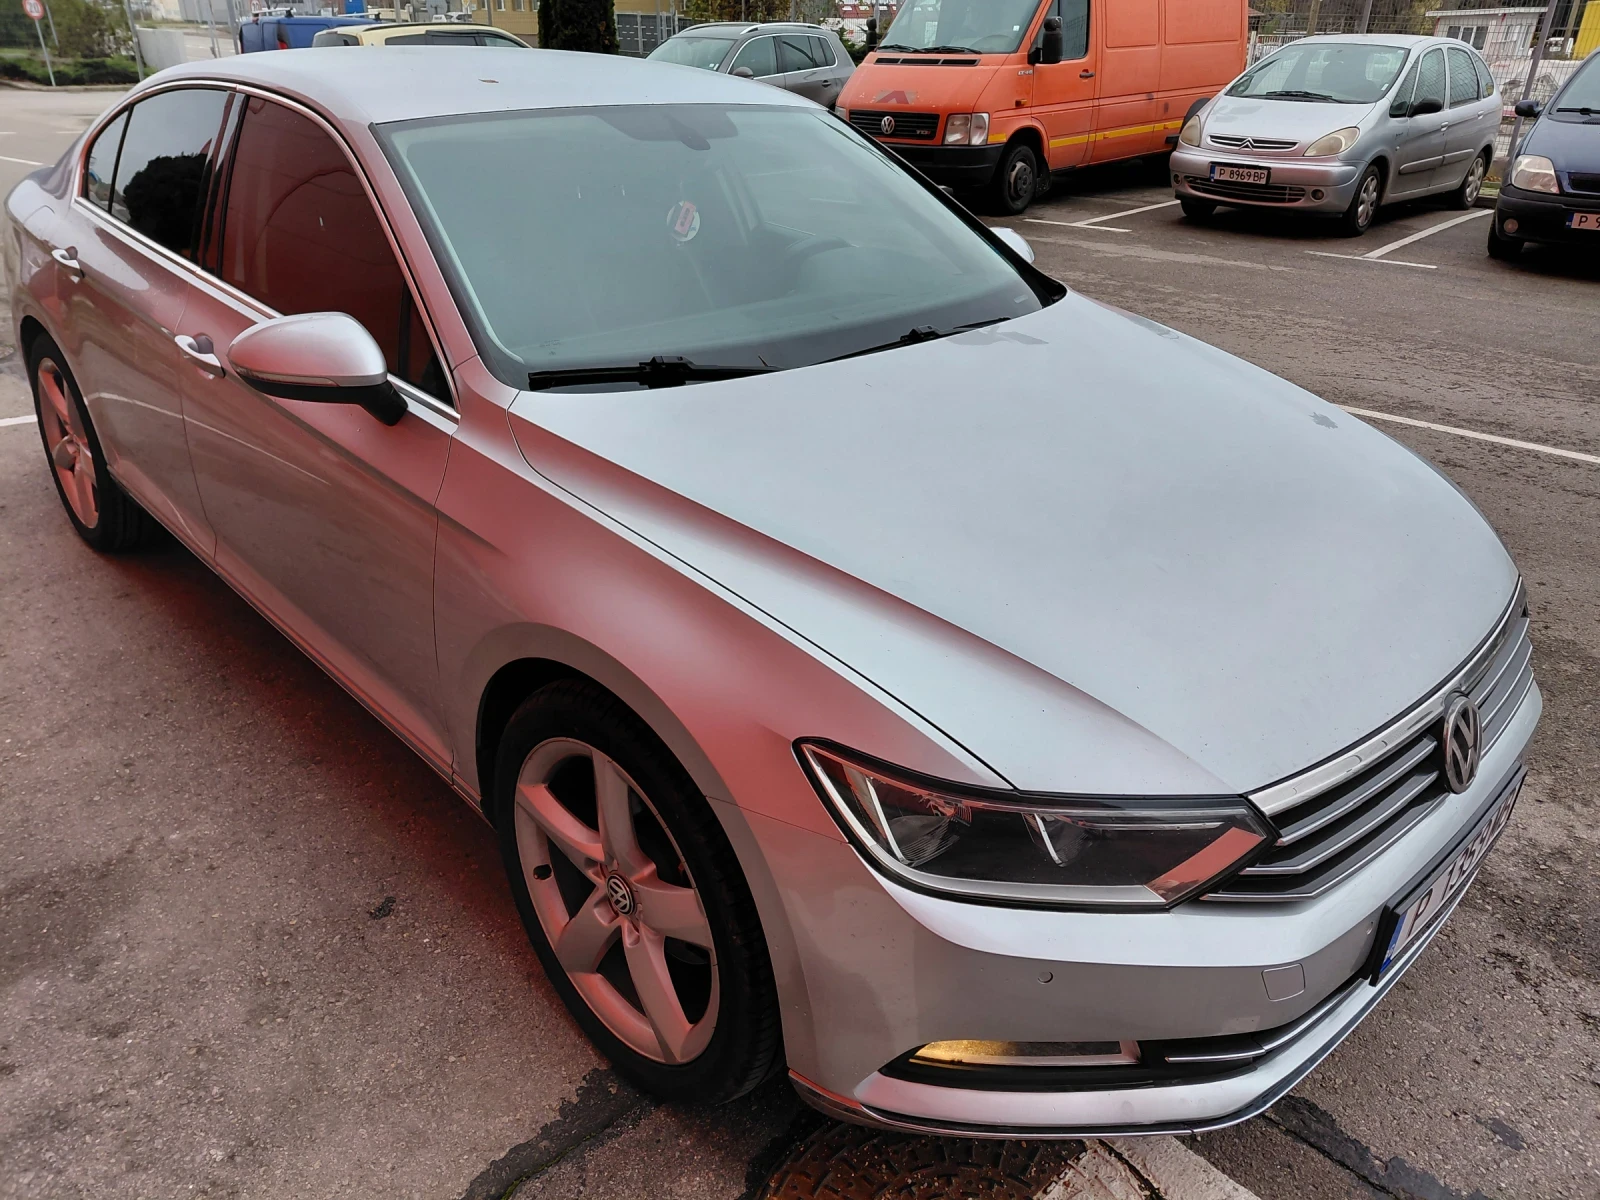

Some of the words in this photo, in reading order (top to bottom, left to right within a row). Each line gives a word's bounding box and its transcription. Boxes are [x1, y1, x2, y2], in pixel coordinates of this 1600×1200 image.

[1219, 168, 1226, 178] P
[1578, 215, 1588, 227] P
[1408, 888, 1433, 938] P
